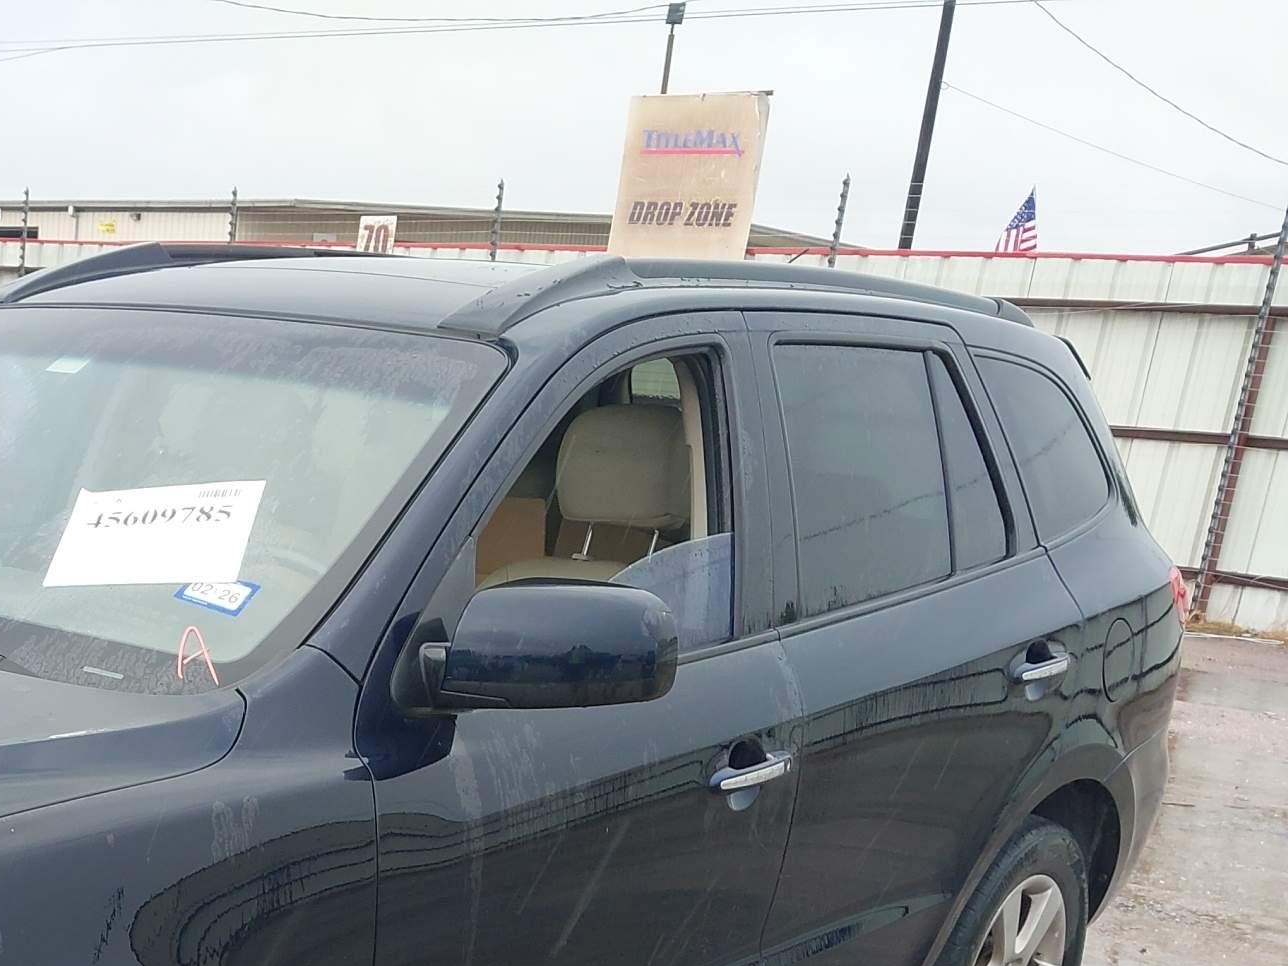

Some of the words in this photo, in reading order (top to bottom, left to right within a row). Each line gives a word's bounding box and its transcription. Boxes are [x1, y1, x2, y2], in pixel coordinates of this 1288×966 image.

[628, 200, 683, 225] DROP
[684, 201, 738, 227] ZONE
[86, 505, 233, 529] 45609785
